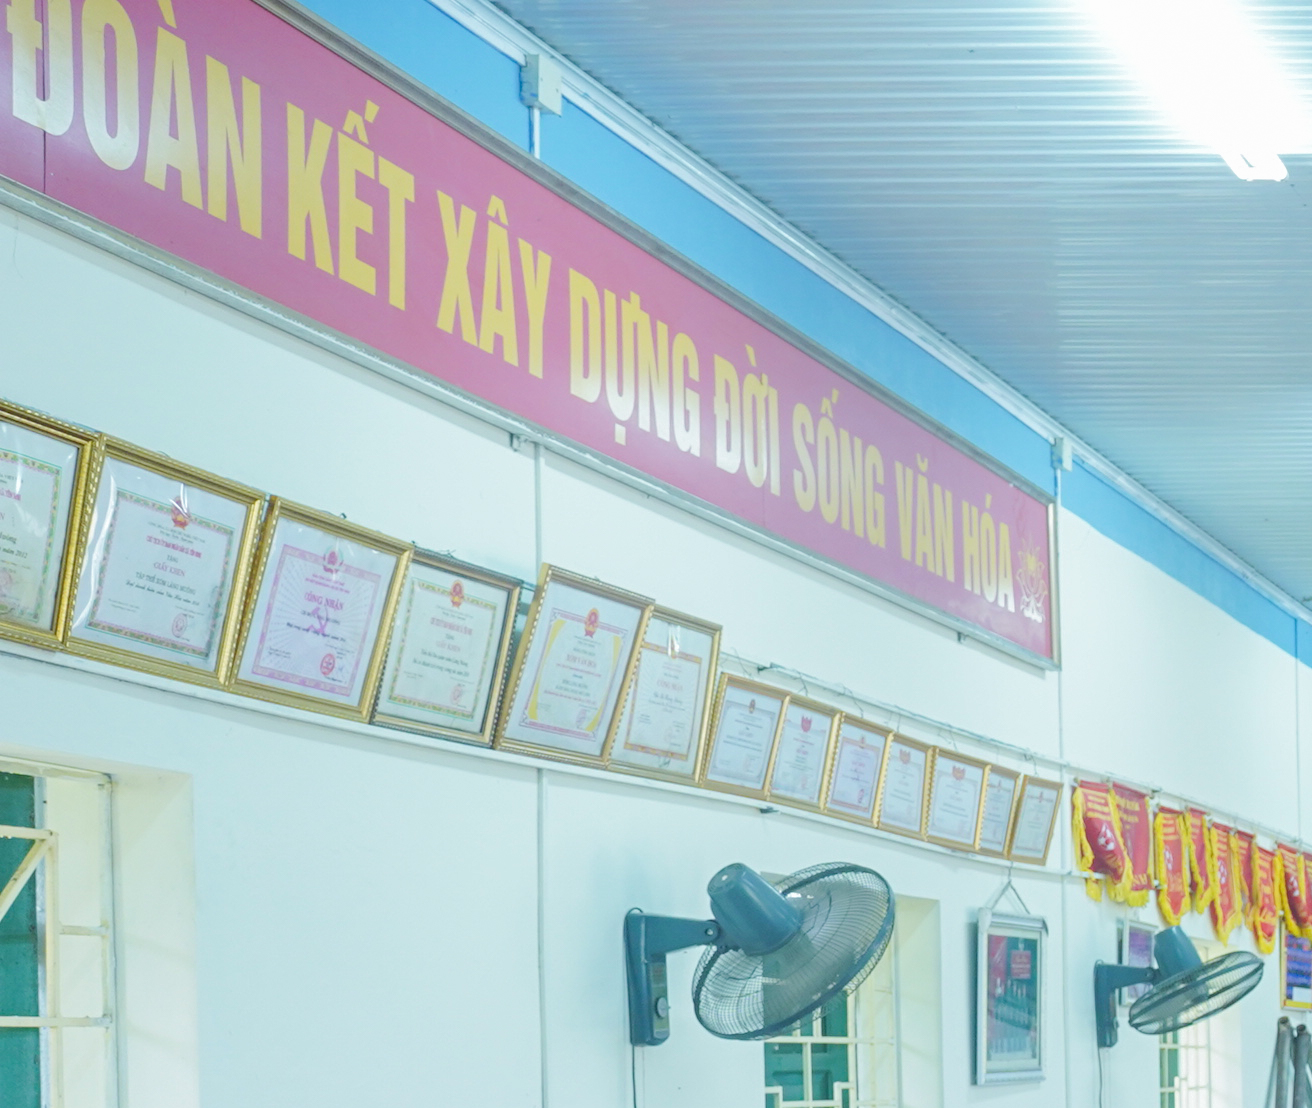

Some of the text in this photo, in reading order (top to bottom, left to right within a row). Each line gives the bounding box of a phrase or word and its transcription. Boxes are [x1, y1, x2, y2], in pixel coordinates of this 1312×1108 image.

[7, 0, 1015, 613] ĐOÀN KẾT XÂY DỤNG ĐỜI SỐNG VĂN HÓA
